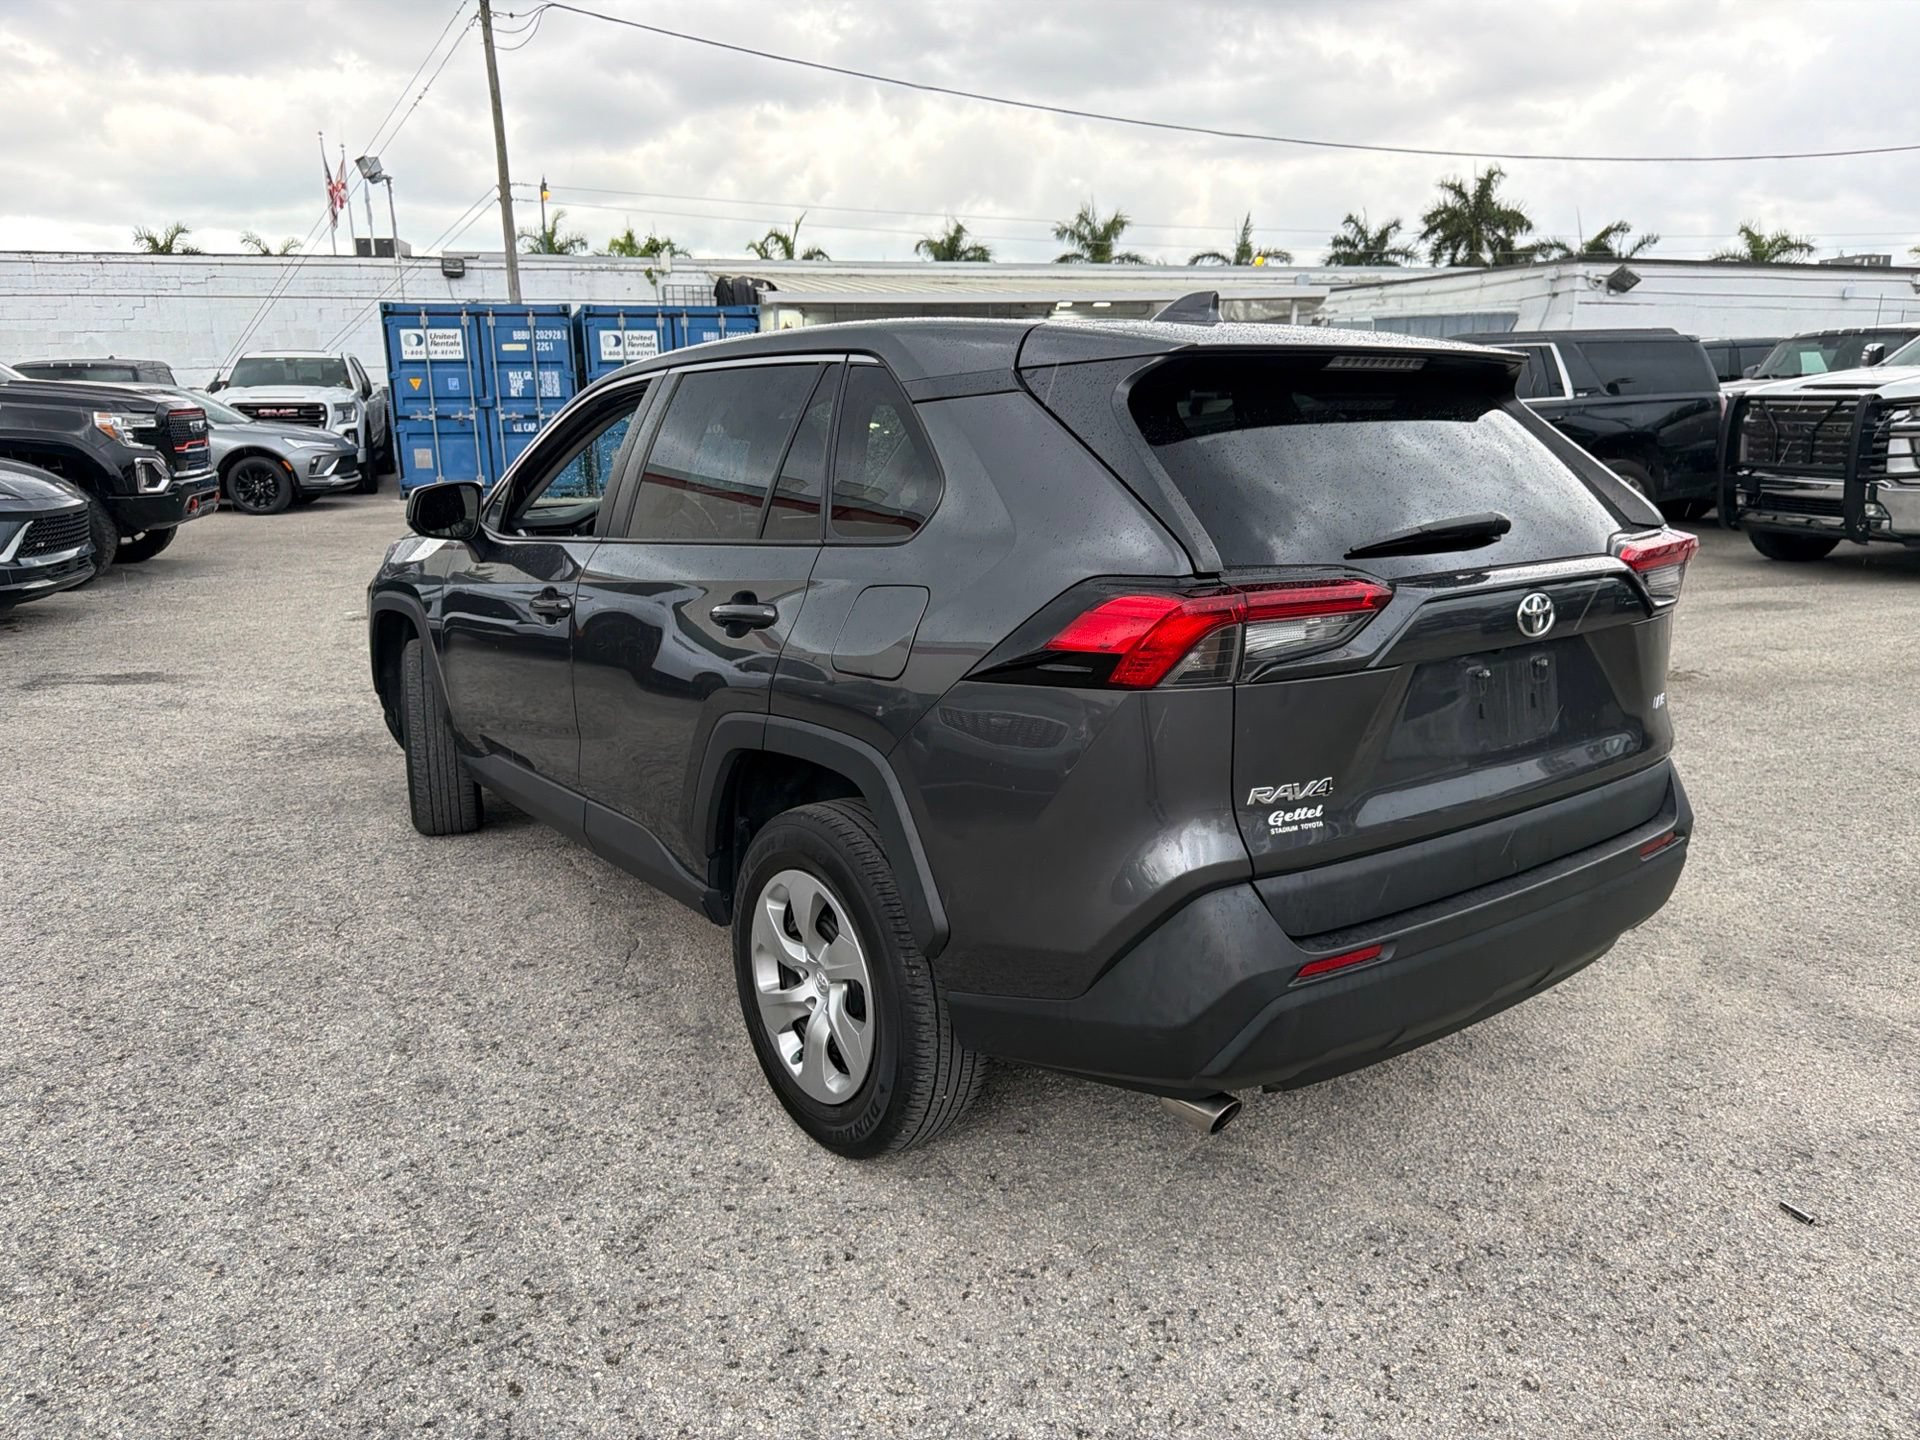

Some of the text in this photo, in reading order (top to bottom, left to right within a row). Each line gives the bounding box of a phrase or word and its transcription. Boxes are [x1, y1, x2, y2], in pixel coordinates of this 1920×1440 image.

[1247, 777, 1334, 805] RAV4
[1268, 804, 1323, 826] Gettel
[1270, 821, 1323, 835] STADIUM TOYOTA
